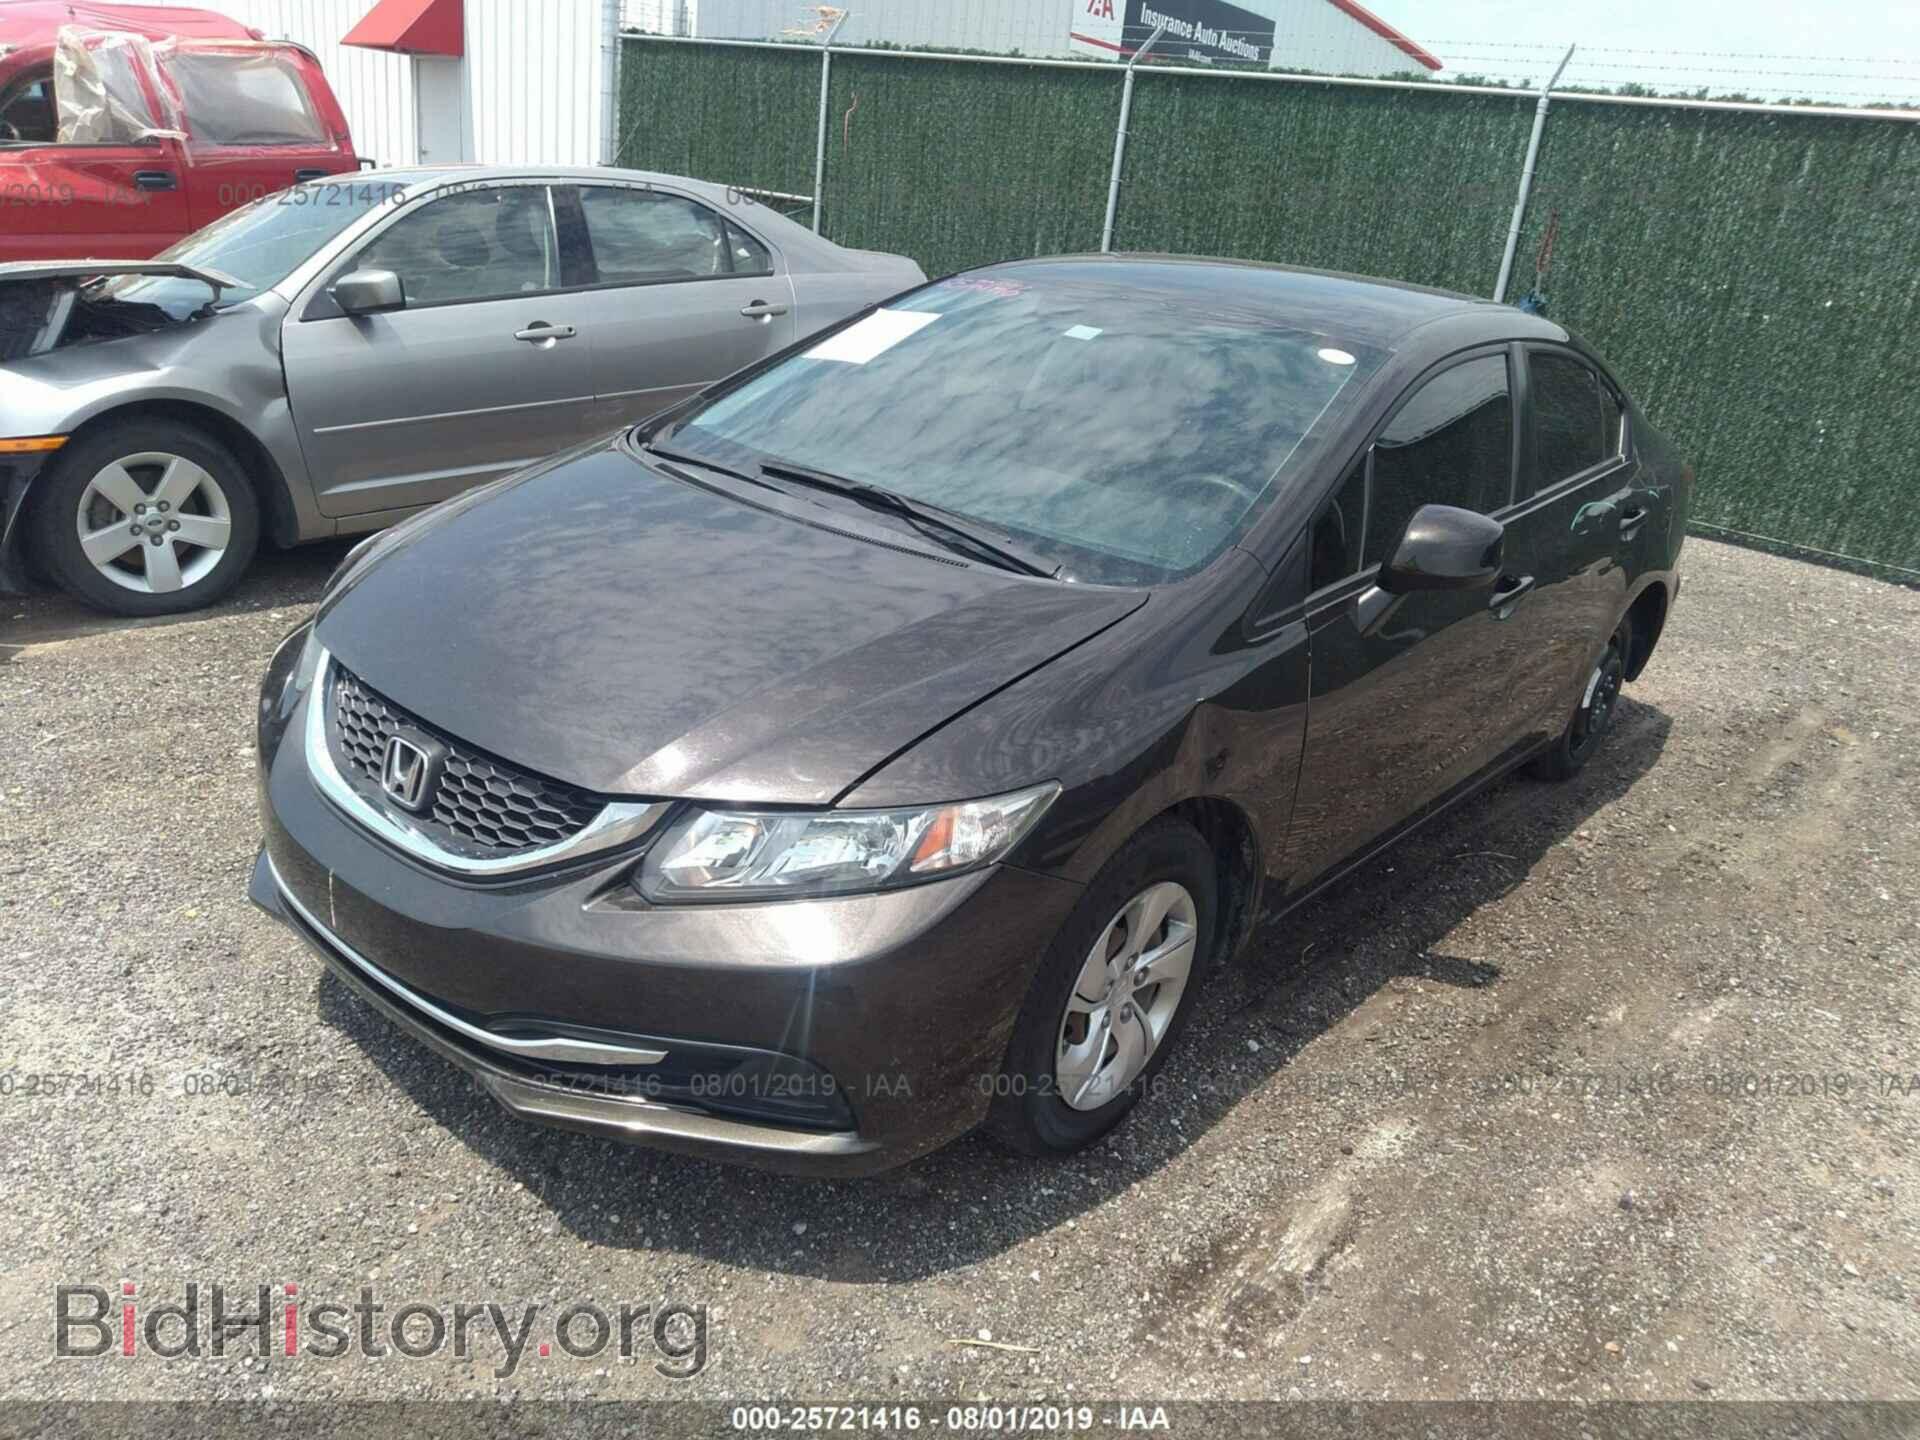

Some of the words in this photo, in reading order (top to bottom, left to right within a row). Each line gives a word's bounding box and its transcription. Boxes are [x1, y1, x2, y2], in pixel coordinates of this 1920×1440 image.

[1140, 2, 1193, 39] Insurance
[1193, 21, 1218, 47] Auto
[1218, 30, 1260, 61] Auctions
